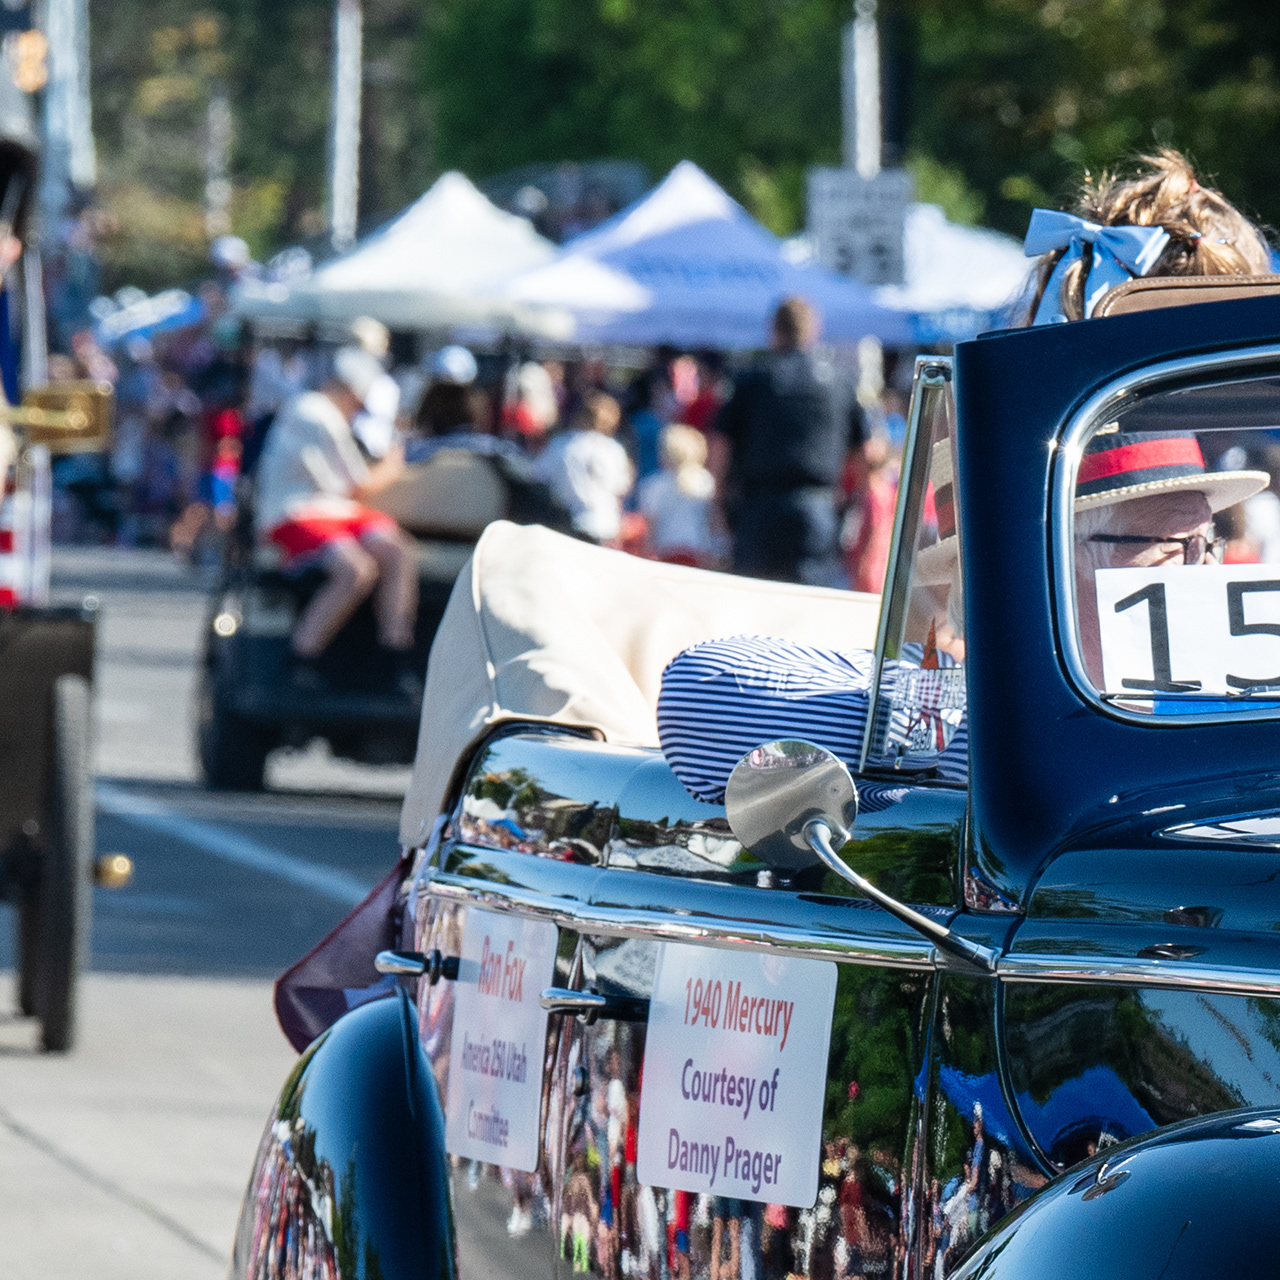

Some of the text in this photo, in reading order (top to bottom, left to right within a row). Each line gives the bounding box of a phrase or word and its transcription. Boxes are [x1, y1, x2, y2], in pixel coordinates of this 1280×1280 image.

[478, 935, 527, 1002] Ron Fox
[684, 977, 795, 1052] 1940 Mercury
[491, 1039, 506, 1079] 250
[507, 1042, 528, 1084] Utah
[681, 1058, 780, 1120] Courtesy of
[667, 1128, 782, 1195] Danny Prager
